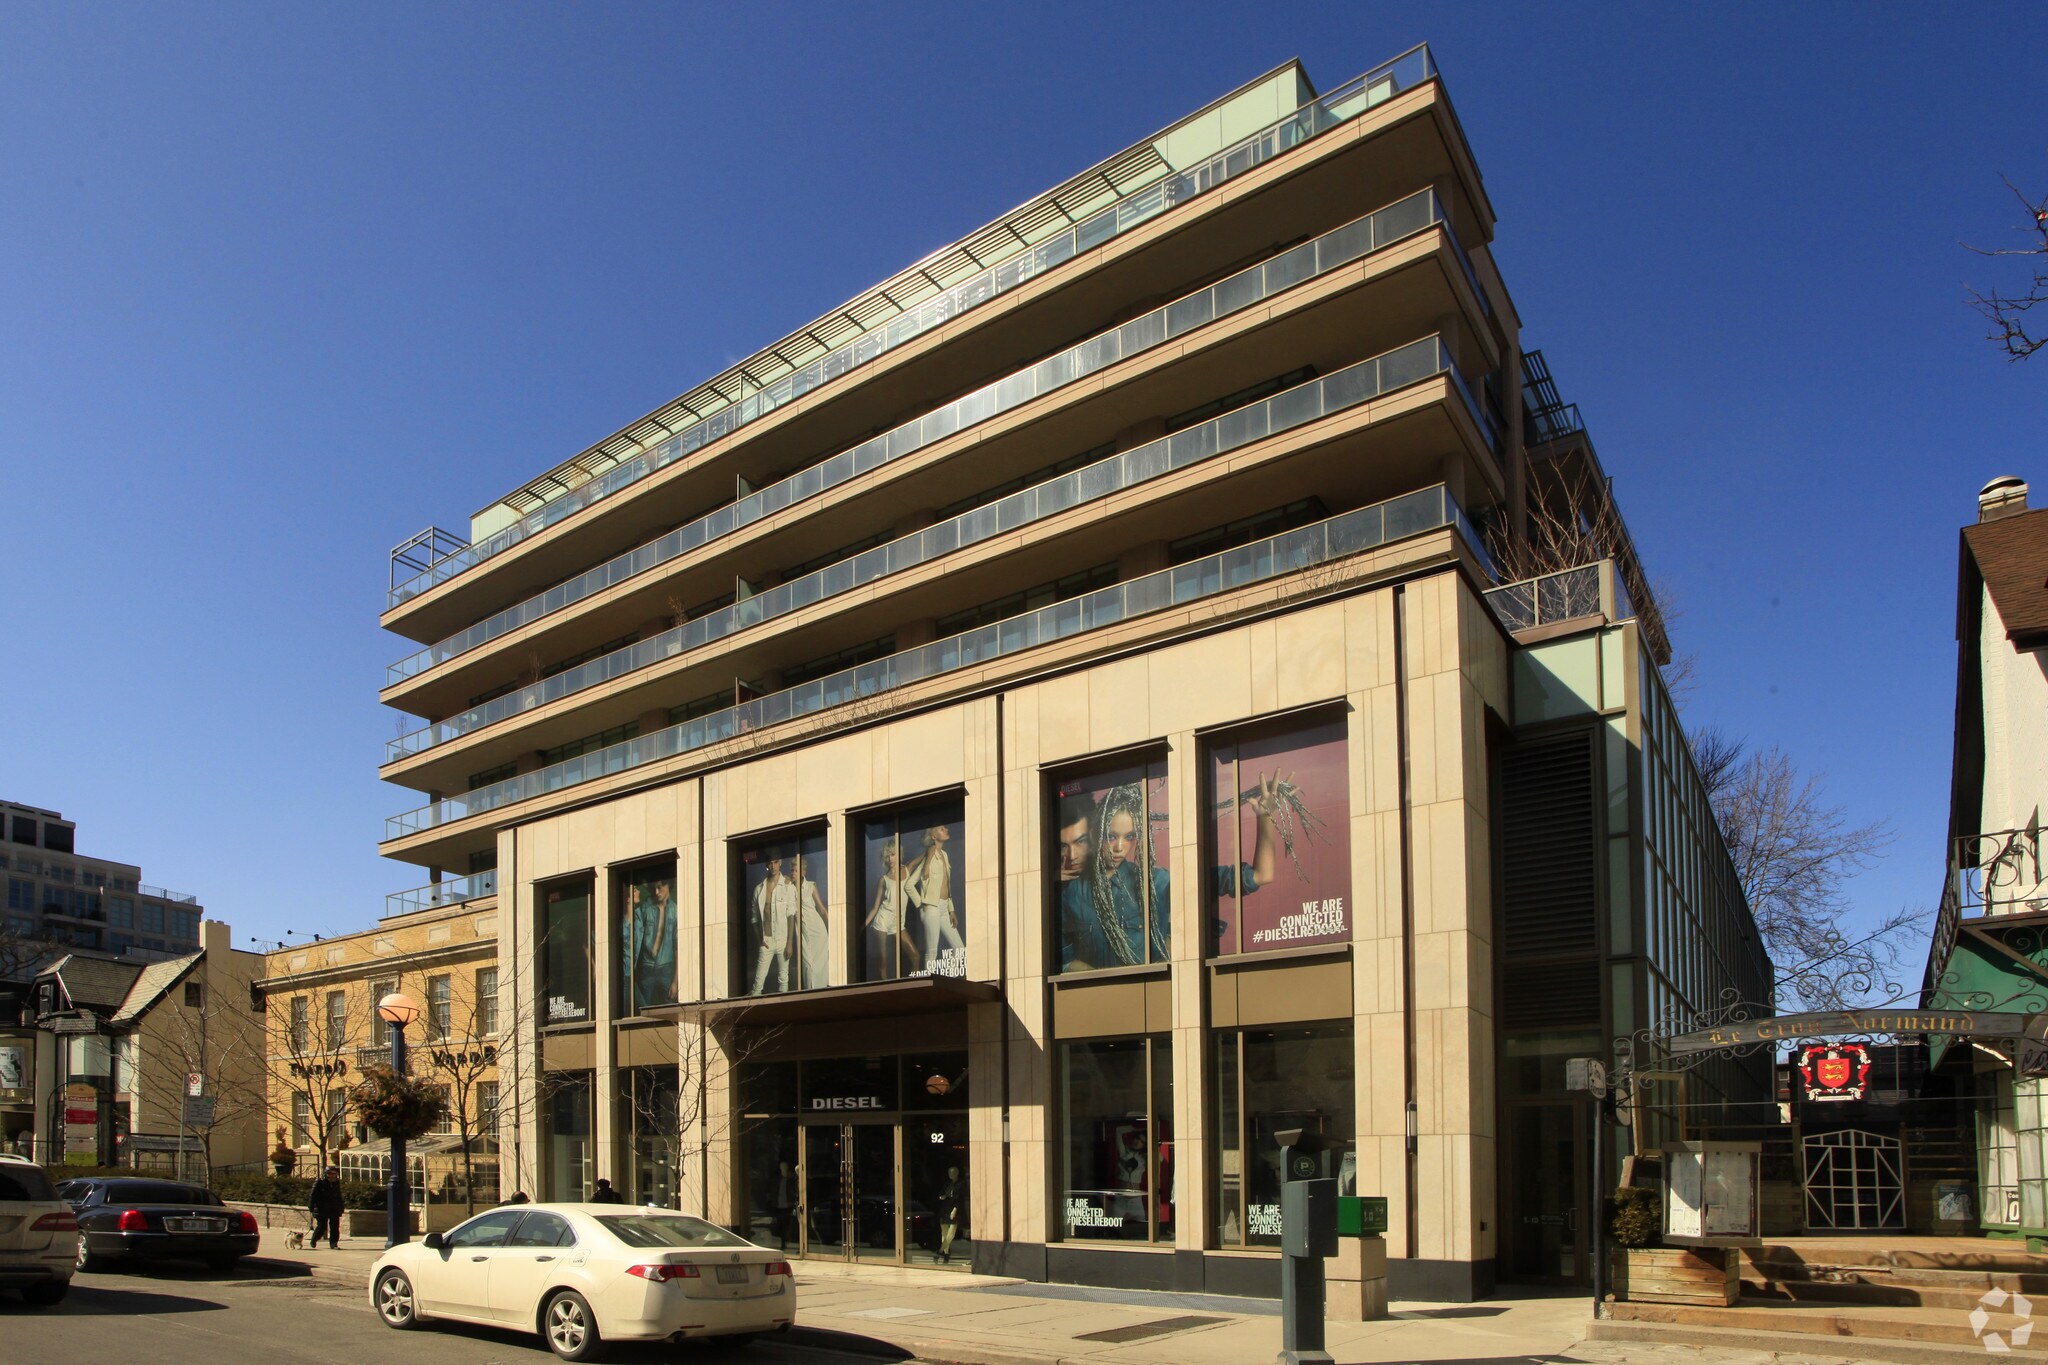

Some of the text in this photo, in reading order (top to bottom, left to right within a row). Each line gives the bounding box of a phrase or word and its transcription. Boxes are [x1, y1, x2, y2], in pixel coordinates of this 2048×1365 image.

[1302, 898, 1343, 914] WE ARE
[1280, 910, 1343, 929] CONNECTED
[942, 949, 953, 959] WE
[1840, 1012, 1976, 1031] Normand
[812, 1097, 882, 1110] DIESEL
[931, 1133, 944, 1143] 92
[1075, 1199, 1089, 1208] ARE
[1067, 1208, 1104, 1218] ONNECTED
[1248, 1205, 1280, 1215] WE ARE
[1248, 1215, 1282, 1225] CONNEC
[1249, 1225, 1282, 1235] #DIESE
